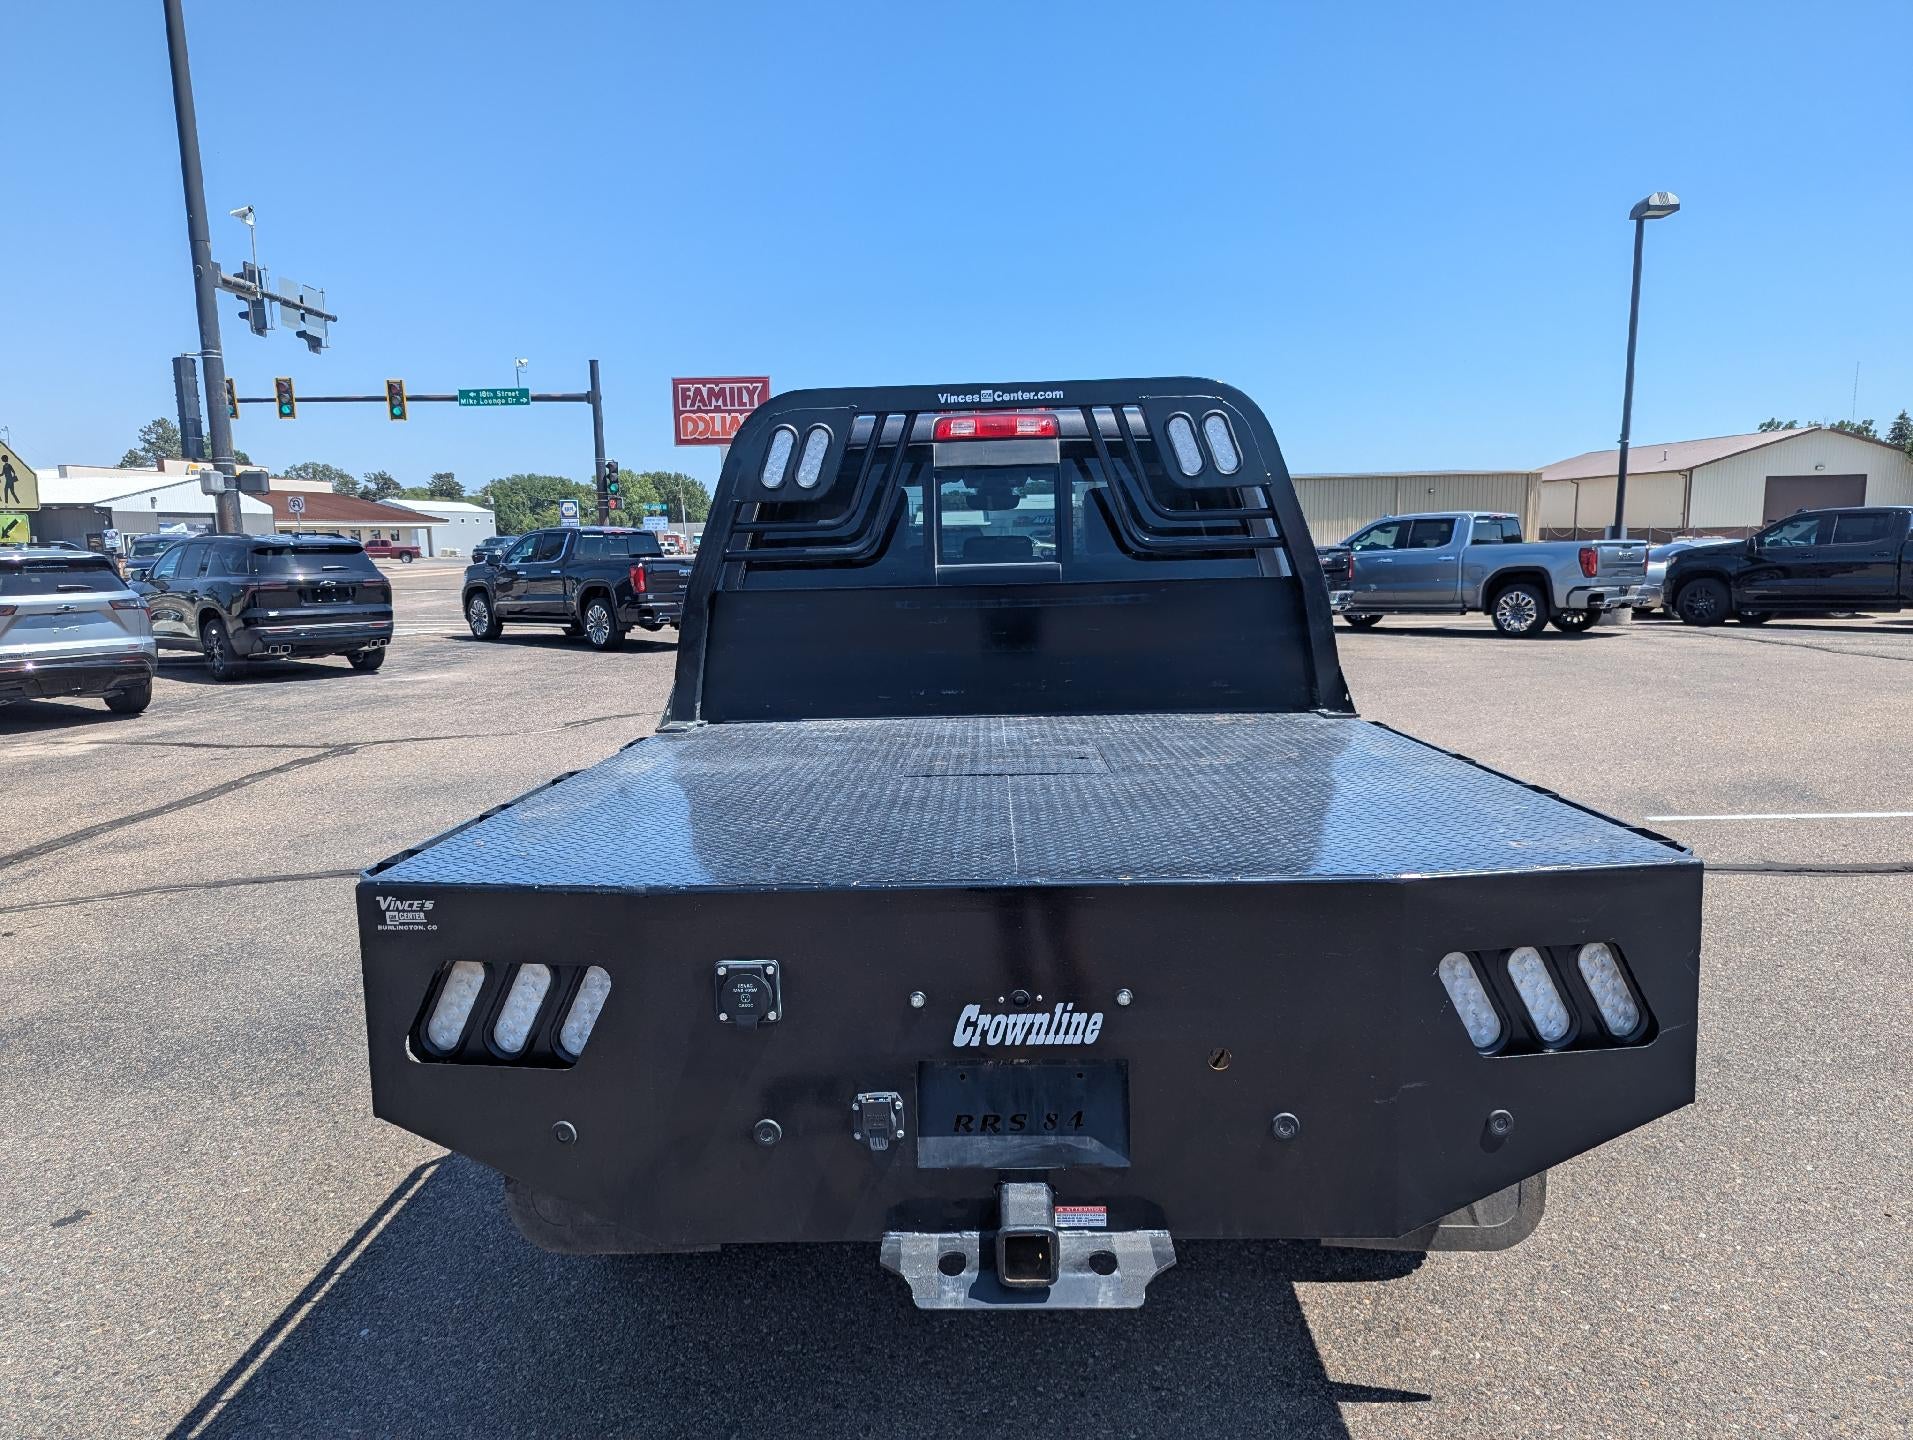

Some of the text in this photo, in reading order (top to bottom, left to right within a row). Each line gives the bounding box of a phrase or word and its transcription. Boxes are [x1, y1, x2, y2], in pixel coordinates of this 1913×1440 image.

[678, 383, 763, 410] FAMILY
[680, 412, 751, 439] DOLLA
[398, 911, 425, 920] CENTER
[952, 1002, 1104, 1048] Crownline
[953, 1109, 1085, 1134] RRS 84
